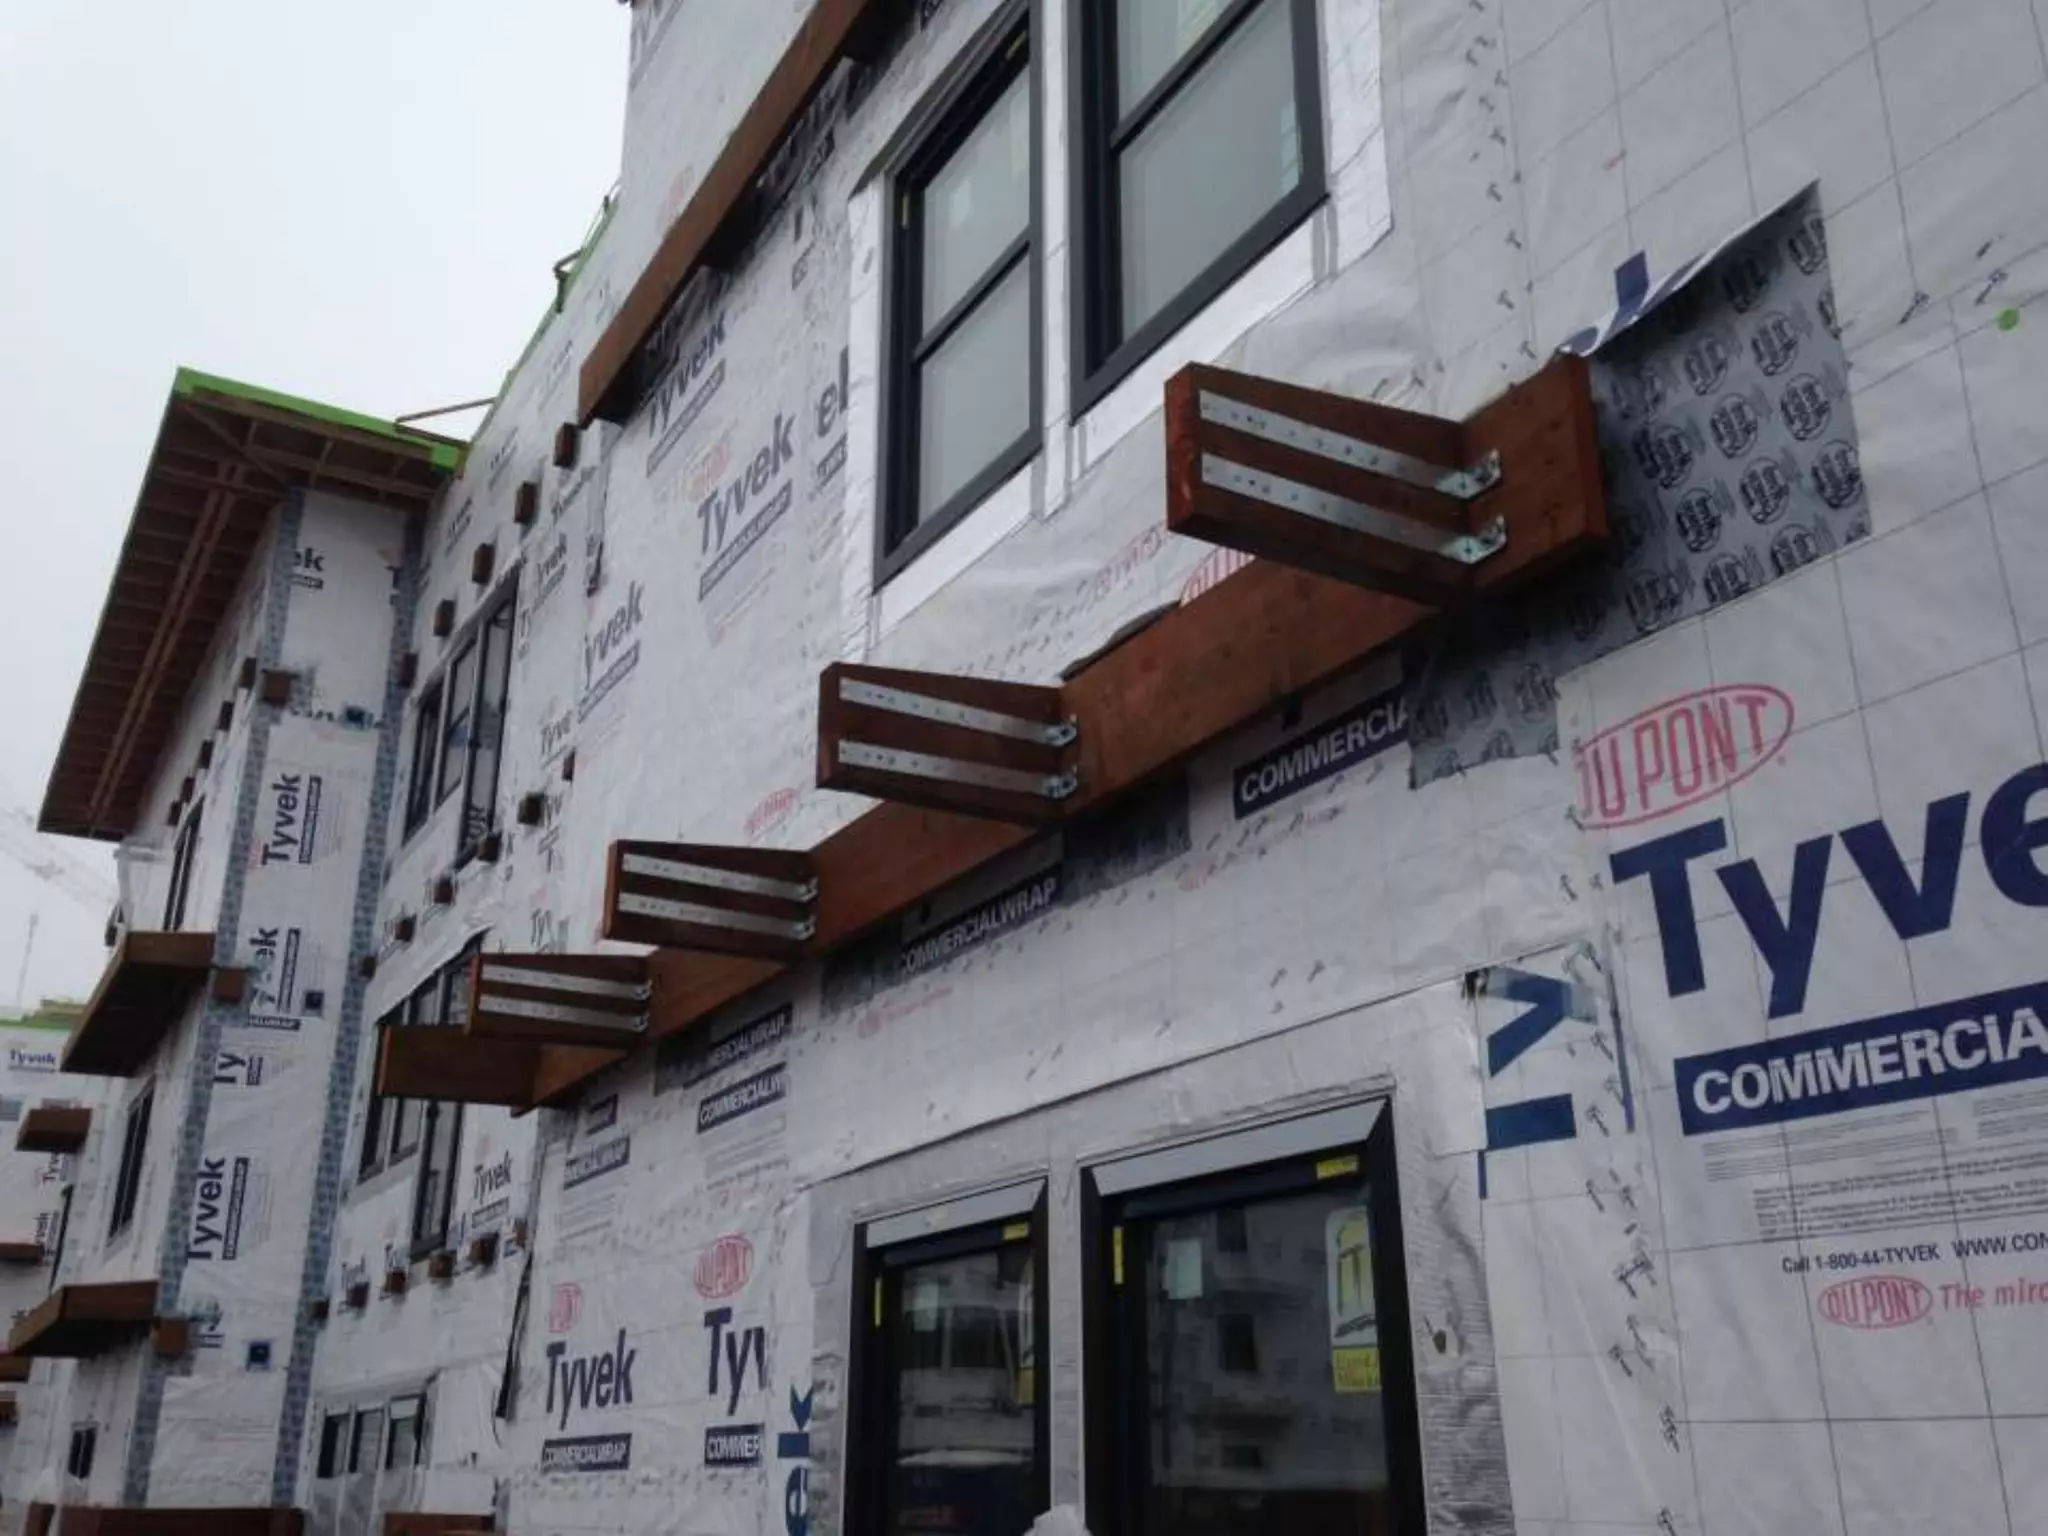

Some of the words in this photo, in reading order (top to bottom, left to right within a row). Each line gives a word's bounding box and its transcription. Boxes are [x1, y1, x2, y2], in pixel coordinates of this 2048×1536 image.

[696, 410, 796, 556] Tyvek
[262, 773, 302, 866] Tyvek
[187, 1157, 226, 1261] Tyvek
[1781, 1255, 1811, 1275] Call
[1814, 1244, 1941, 1271] 1-800-44-TYVEK
[1940, 1283, 1987, 1311] The
[546, 1328, 638, 1433] Tyvek
